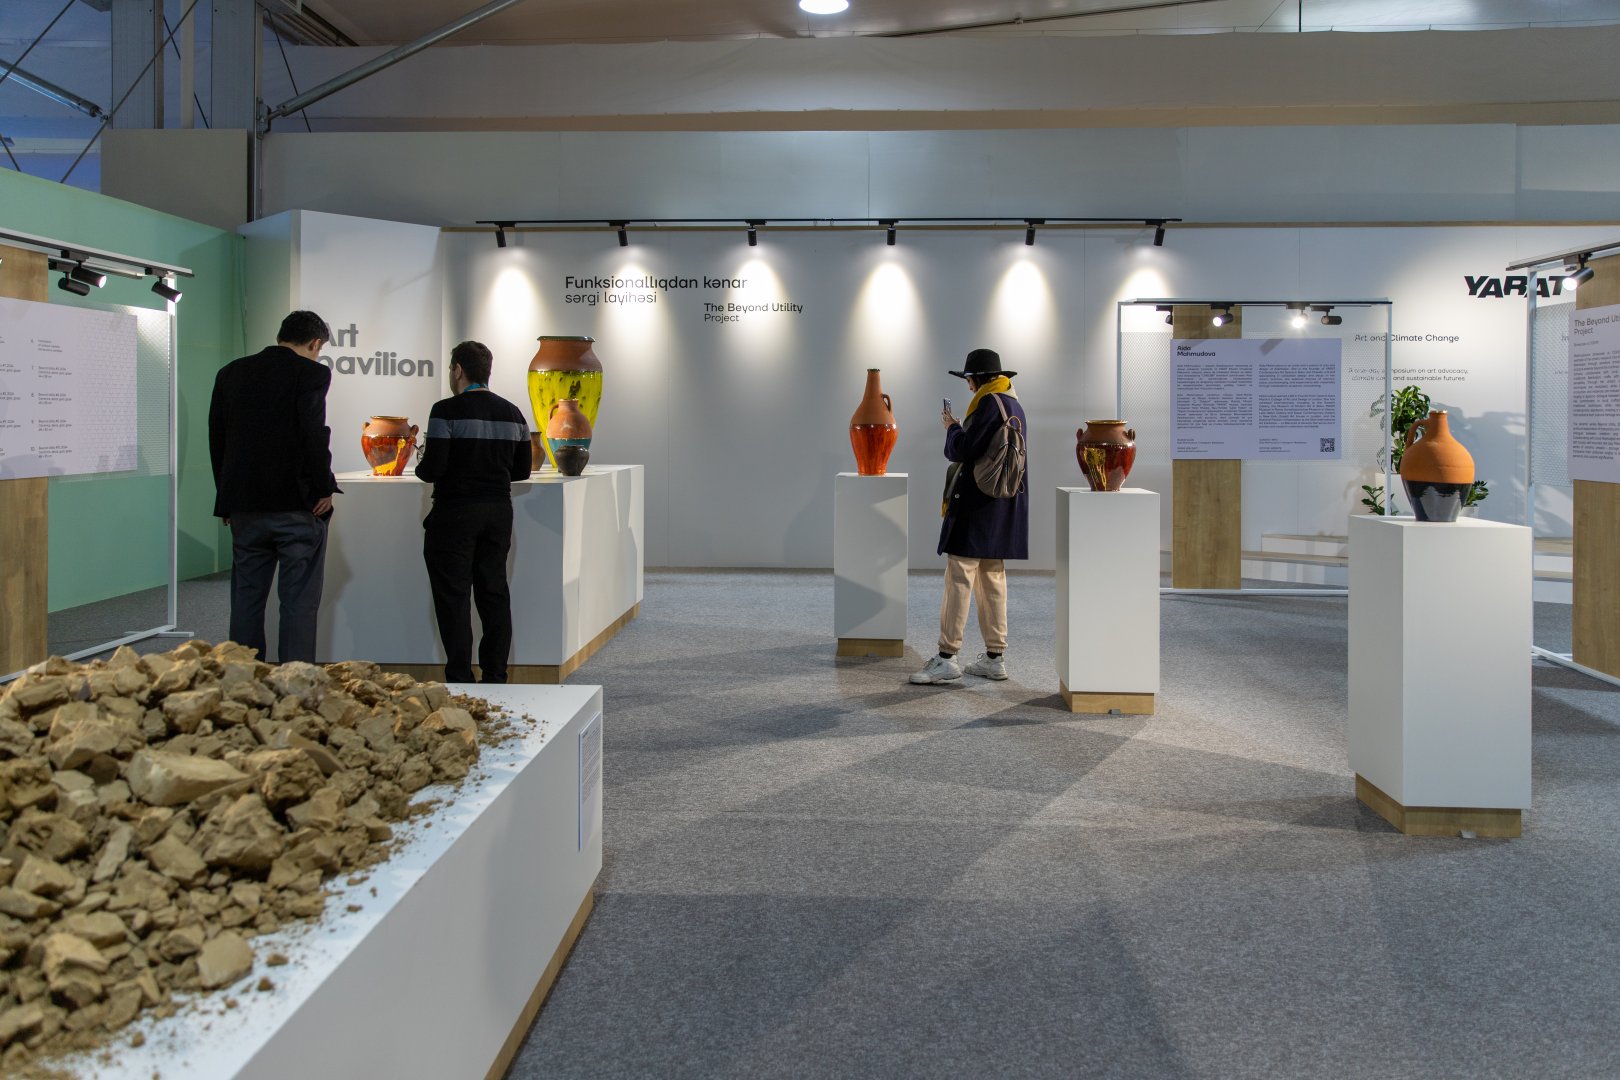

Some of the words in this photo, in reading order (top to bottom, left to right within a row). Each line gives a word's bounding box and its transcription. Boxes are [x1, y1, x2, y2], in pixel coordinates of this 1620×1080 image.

[565, 275, 698, 291] Funksionallıqdan
[703, 275, 747, 289] kənar
[565, 291, 600, 306] sərgi
[604, 291, 657, 306] layihəsi
[704, 302, 725, 312] The
[727, 302, 769, 313] Beyond
[772, 302, 804, 314] Utility
[704, 313, 740, 324] Project
[1573, 327, 1594, 336] Project
[1391, 334, 1423, 342] Climate
[1425, 333, 1460, 343] Change
[1437, 367, 1469, 376] advocacy,
